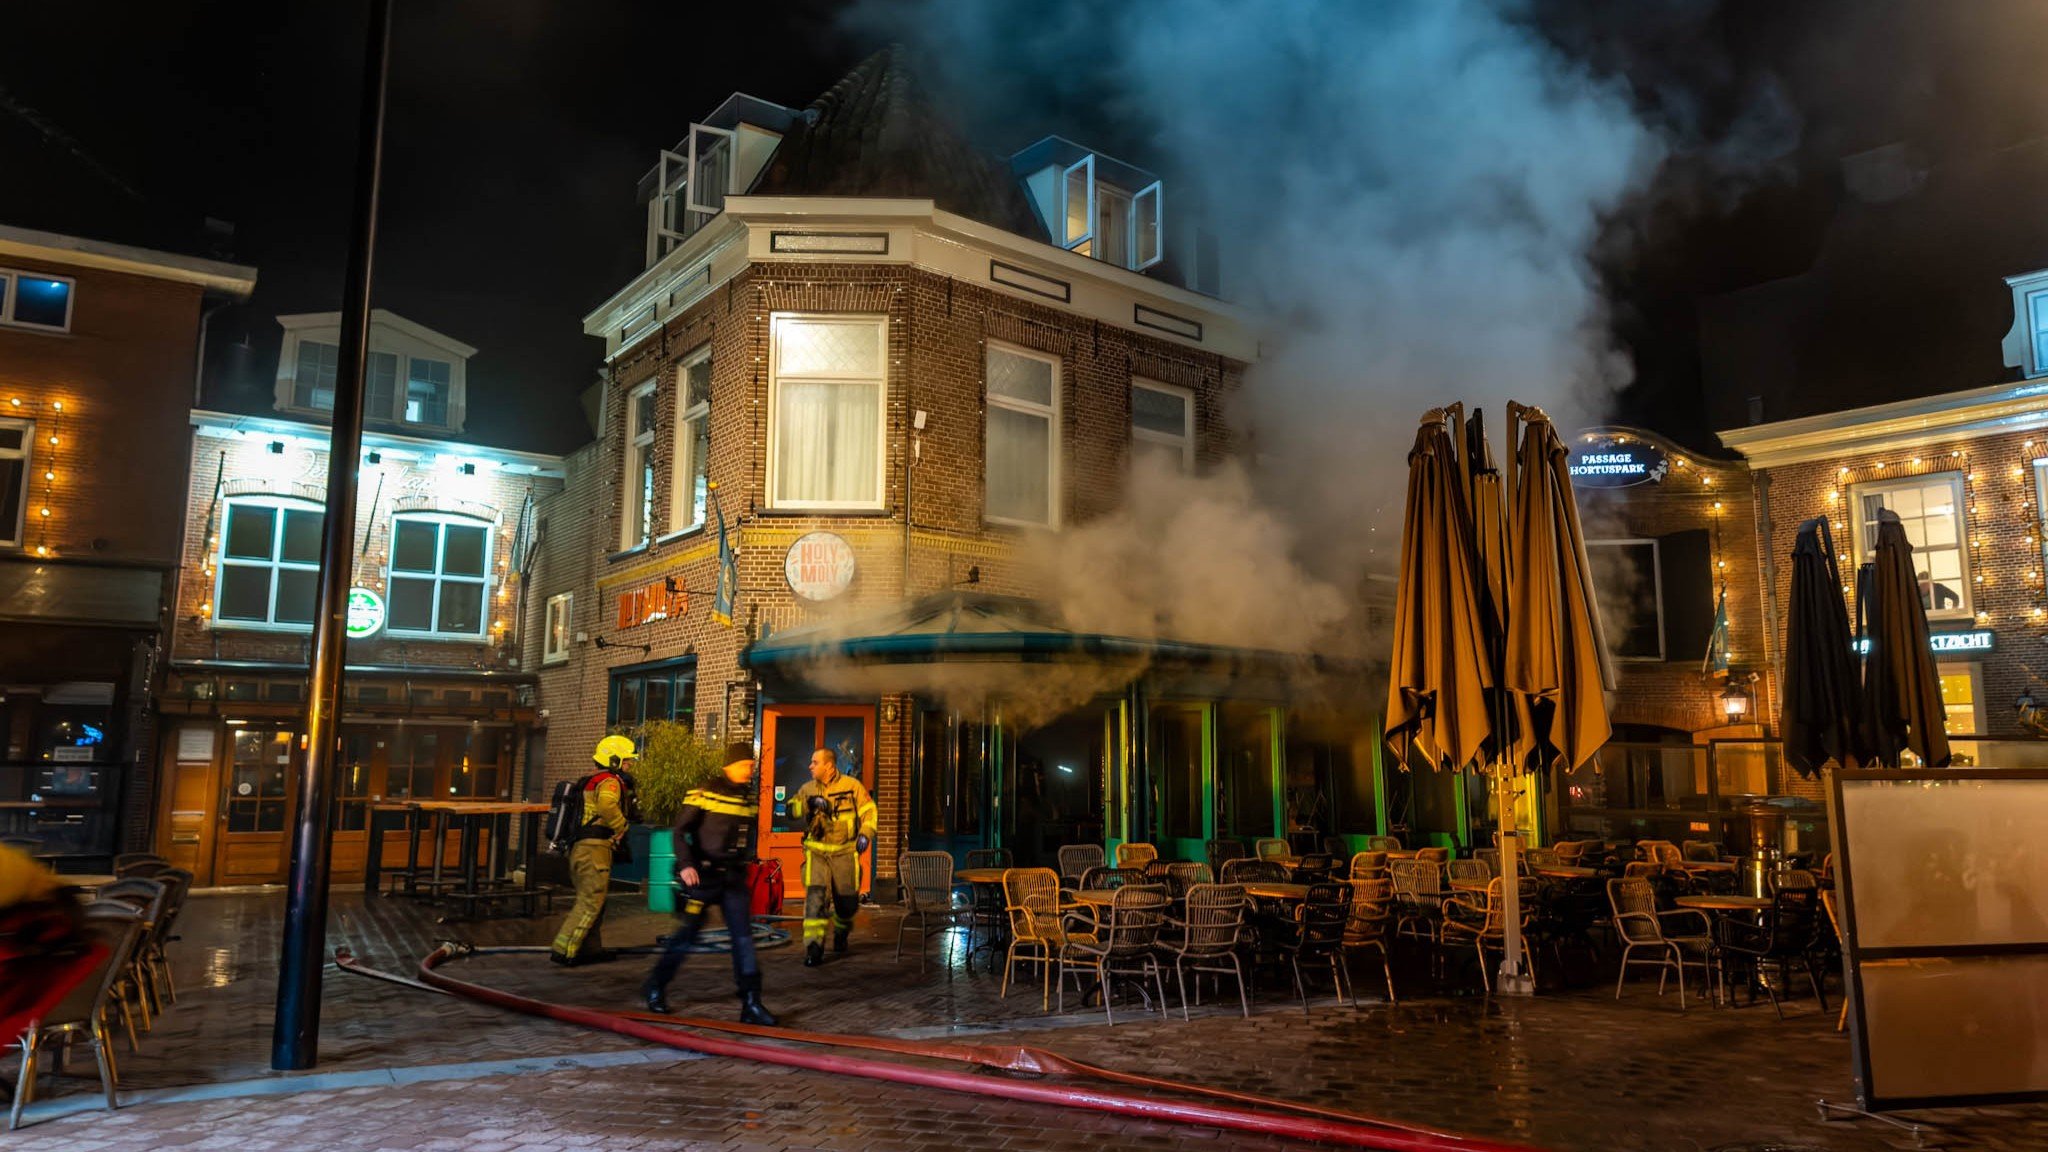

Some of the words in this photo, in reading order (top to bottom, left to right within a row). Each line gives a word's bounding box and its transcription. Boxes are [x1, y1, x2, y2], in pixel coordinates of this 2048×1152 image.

[1581, 453, 1632, 464] PASSAGE
[1570, 463, 1645, 475] HORTUSPARK
[800, 543, 838, 564] HOLY
[800, 564, 838, 583] MOLY
